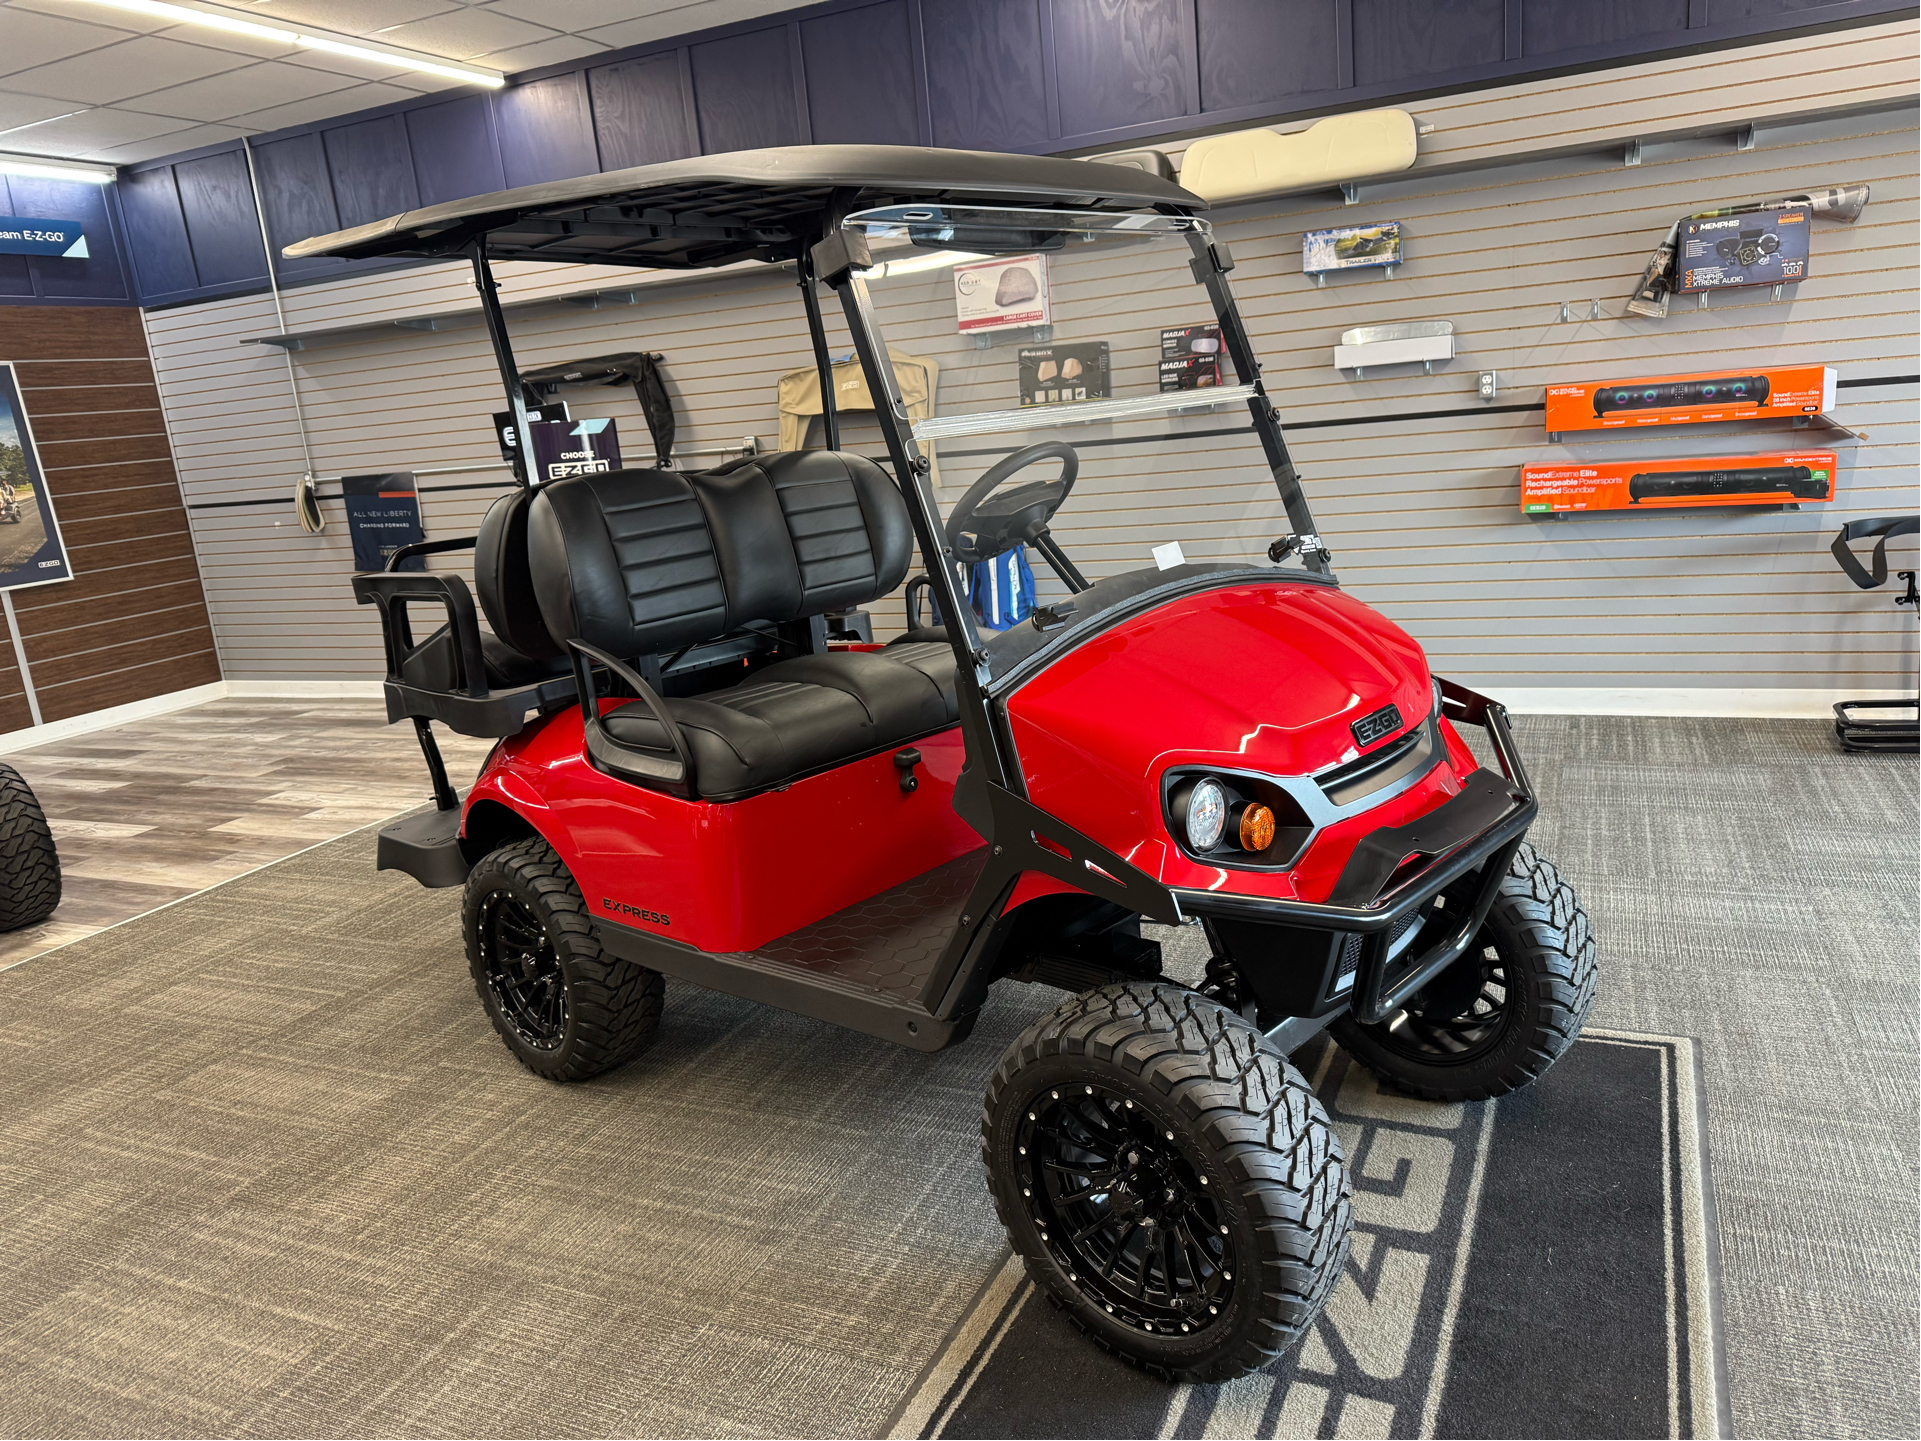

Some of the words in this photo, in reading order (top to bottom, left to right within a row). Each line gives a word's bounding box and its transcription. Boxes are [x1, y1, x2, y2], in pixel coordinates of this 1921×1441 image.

[1700, 219, 1740, 231] MEMPHIS
[1345, 257, 1372, 265] TRAILER
[1783, 266, 1799, 275] 100
[1685, 269, 1693, 288] MXA
[1693, 272, 1724, 281] MEMPHIS
[1693, 279, 1720, 287] XTREME
[1721, 275, 1744, 284] AUDIO
[1163, 329, 1191, 338] MADJAX
[1161, 359, 1195, 370] MADJAX
[561, 450, 595, 460] CHOOSE
[1526, 471, 1579, 479] SoundExtreme
[1526, 479, 1578, 488] Rechargeable
[1579, 477, 1622, 486] Powersports
[1526, 487, 1561, 497] Amplified
[1562, 486, 1596, 494] Soundbar
[1356, 708, 1400, 741] EZGO
[603, 898, 671, 926] EXPRESS
